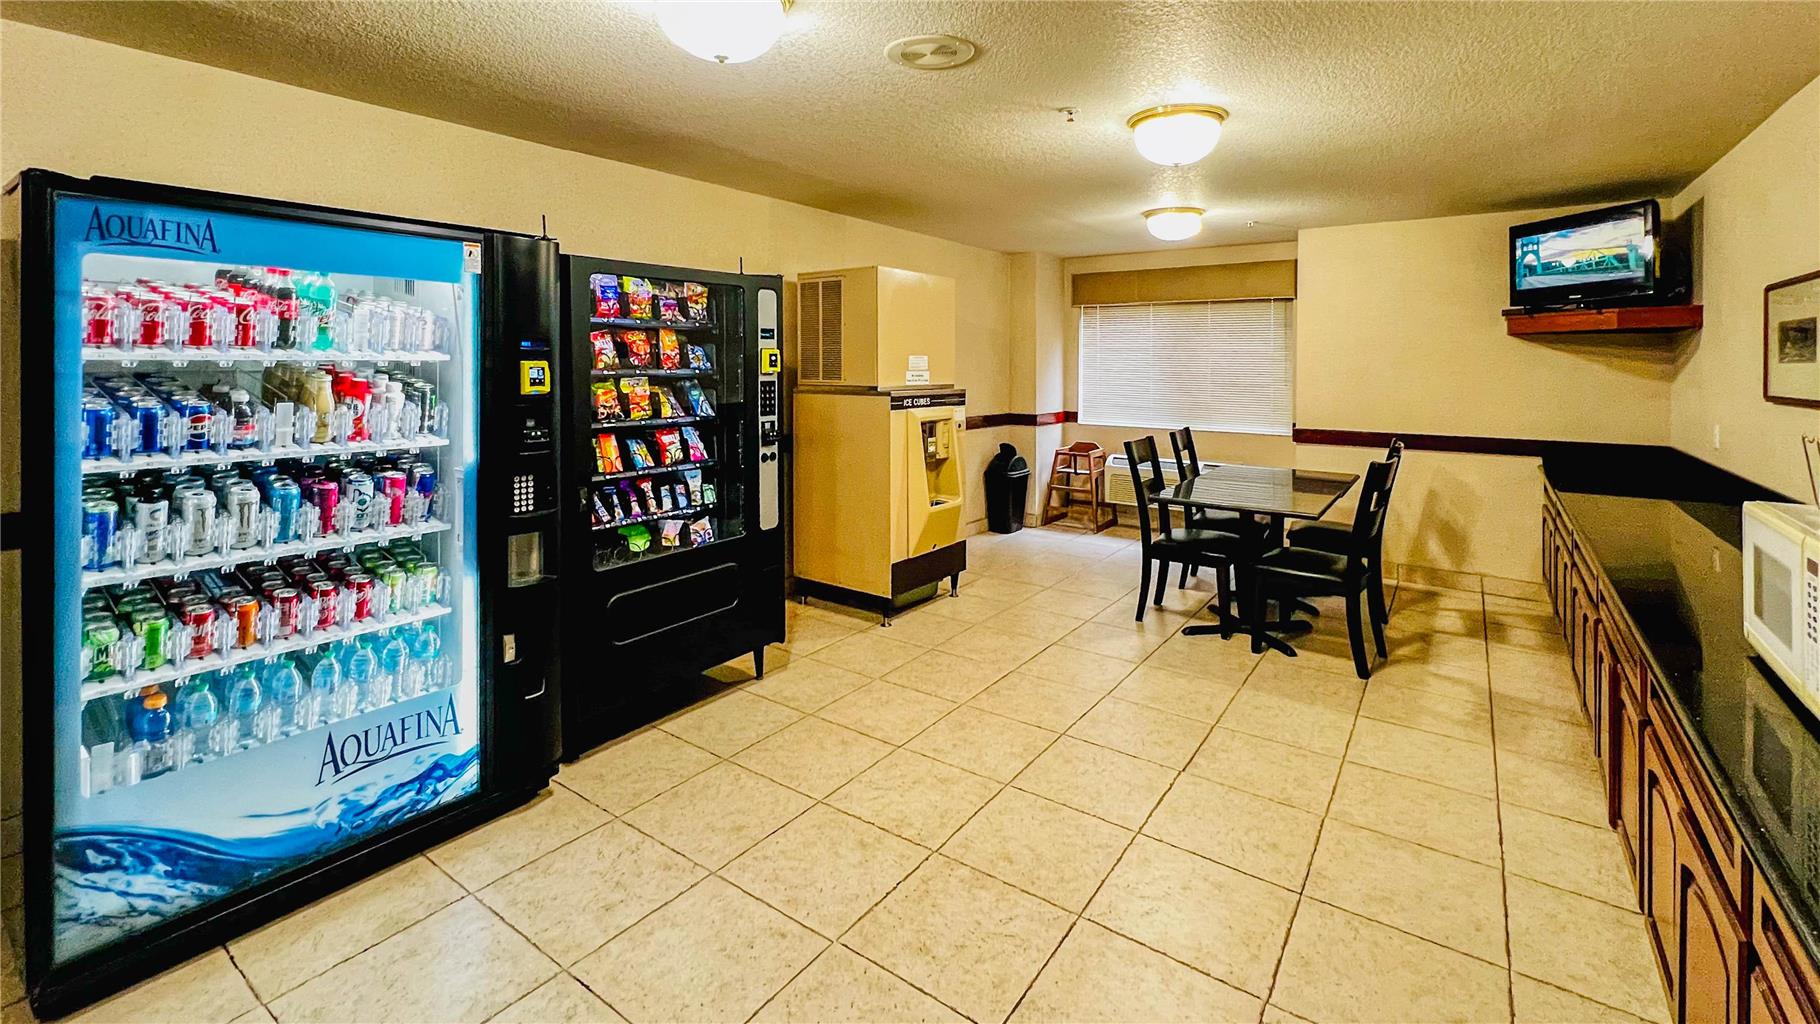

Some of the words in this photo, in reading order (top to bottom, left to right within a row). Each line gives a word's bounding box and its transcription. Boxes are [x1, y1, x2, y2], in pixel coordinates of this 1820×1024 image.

[84, 204, 219, 254] AQUAFINA
[903, 398, 912, 407] ICE
[913, 397, 931, 407] CUBES
[315, 692, 462, 787] AQUAFINA
